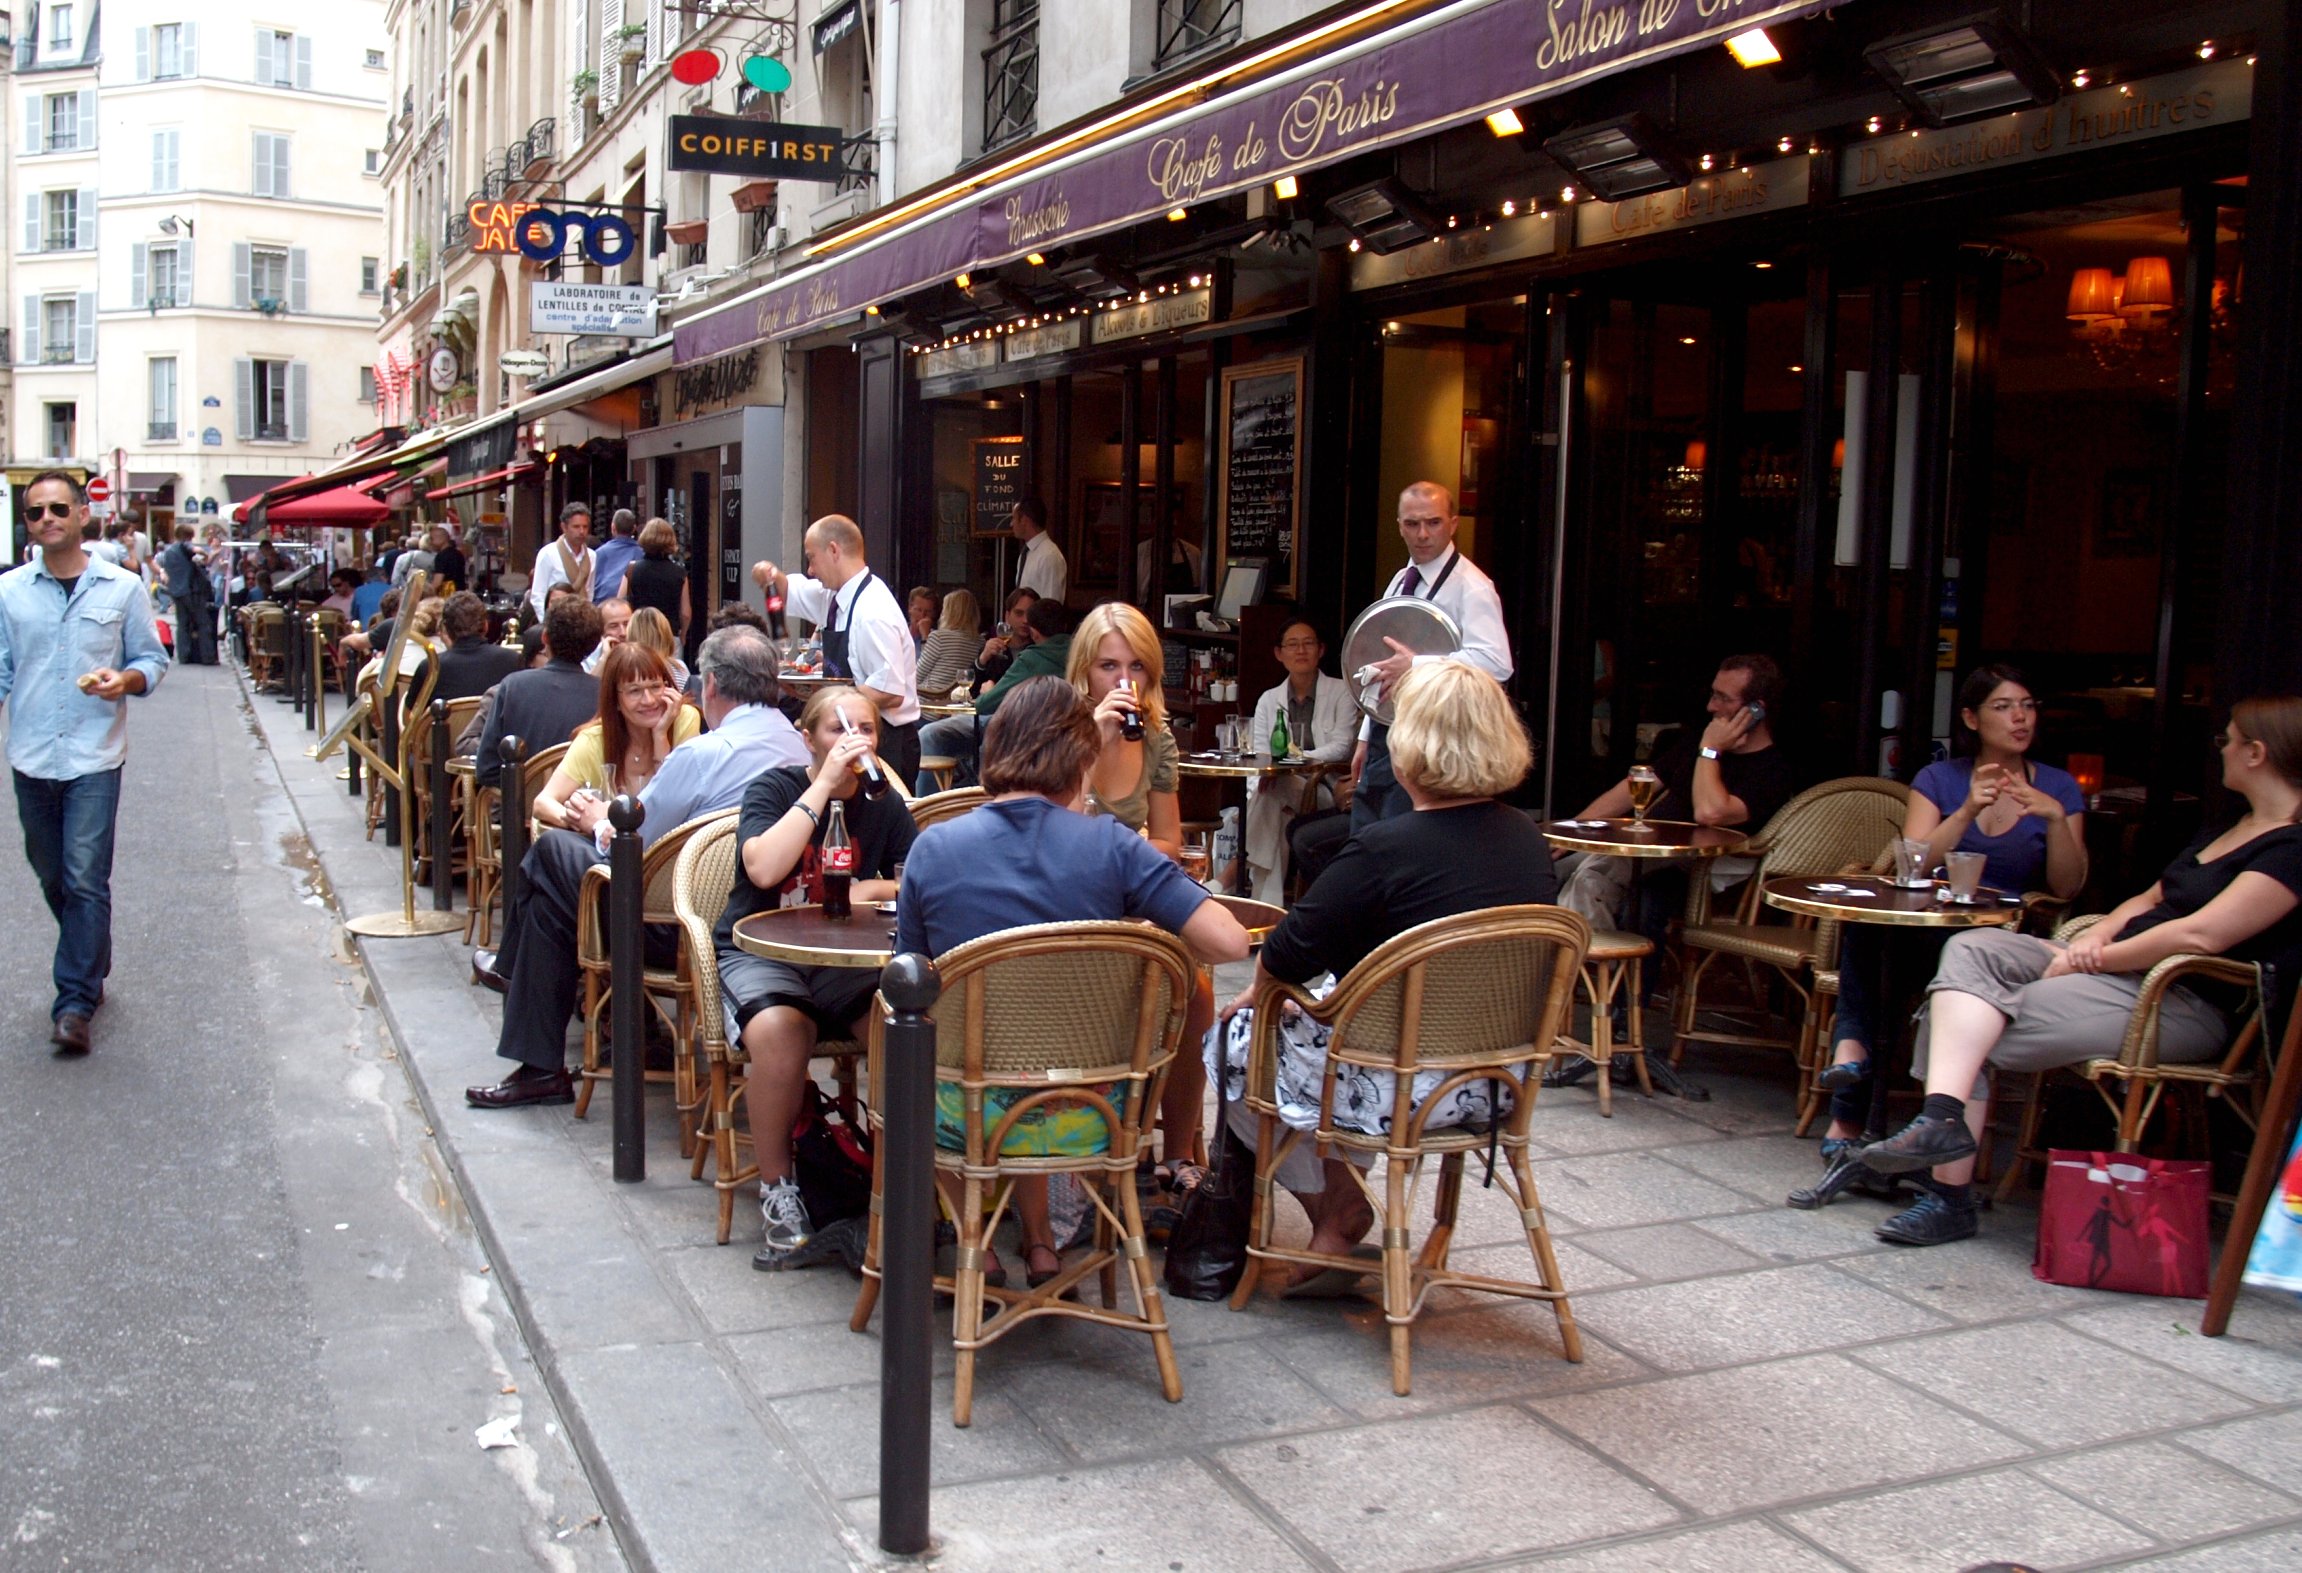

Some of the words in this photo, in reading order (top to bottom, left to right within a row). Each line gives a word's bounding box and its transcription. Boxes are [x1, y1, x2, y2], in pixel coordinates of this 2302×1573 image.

[1536, 0, 1630, 70] Salon
[1148, 134, 1222, 202] Café
[1233, 121, 1266, 170] de
[1278, 77, 1399, 160] Paris
[1006, 191, 1071, 246] Brasserie
[553, 287, 622, 300] LABORATOIRE
[629, 291, 641, 301] de
[538, 299, 588, 312] LENTILLES
[592, 303, 604, 313] de
[608, 303, 648, 315] CONTAC
[757, 296, 781, 336] Café
[785, 292, 799, 325] de
[804, 278, 839, 319] Paris
[545, 312, 577, 321] centre
[1097, 315, 1135, 338] Alcools
[1138, 314, 1148, 329] &
[1152, 296, 1208, 328] Liqueurs
[985, 455, 1021, 468] SALLE
[992, 473, 1007, 481] DU
[984, 485, 1014, 494] FOND
